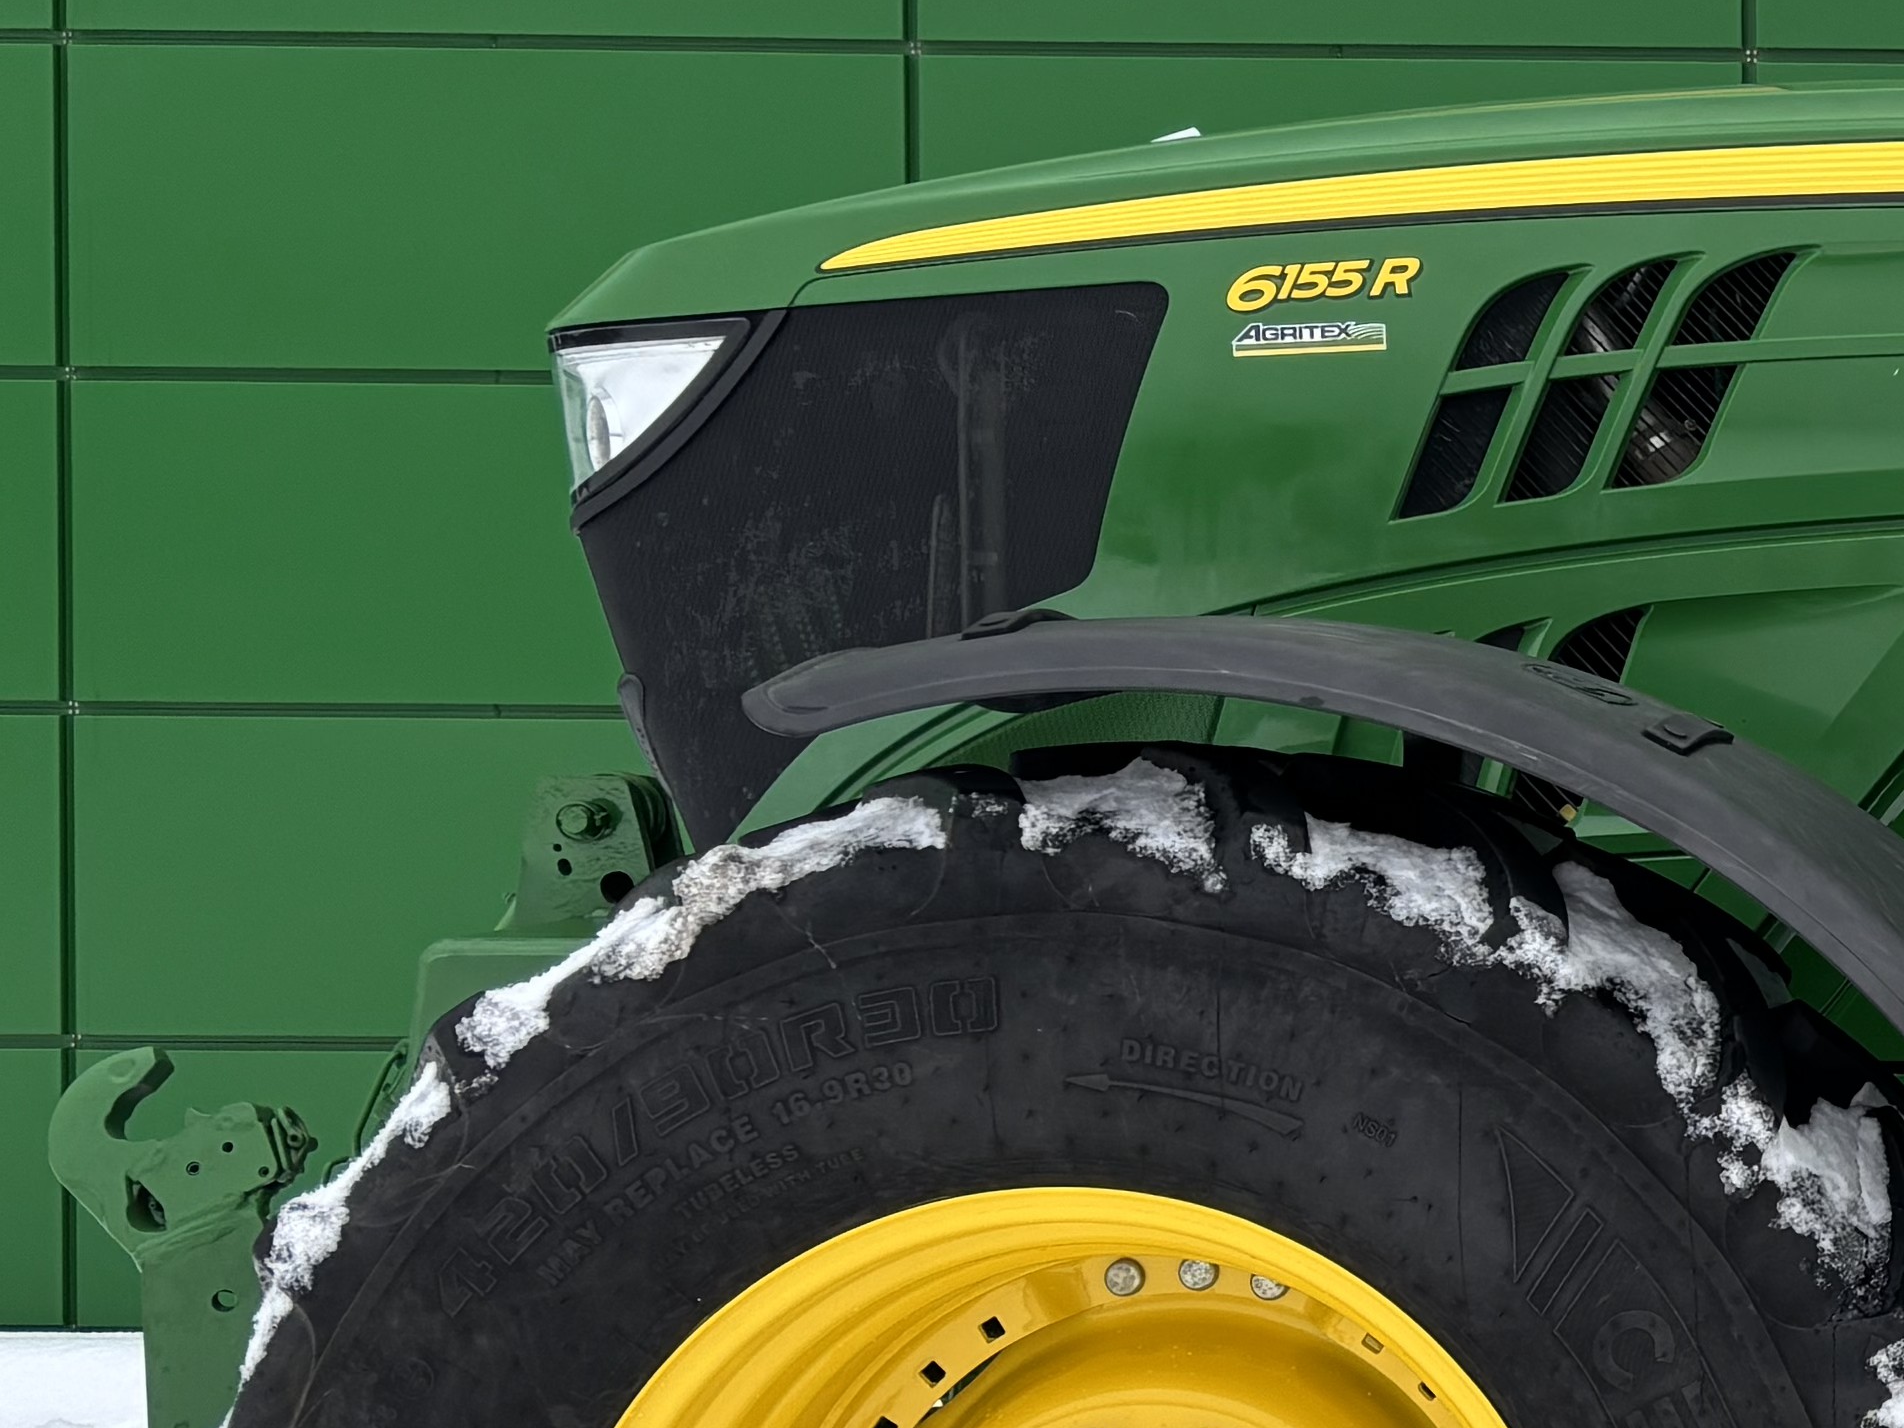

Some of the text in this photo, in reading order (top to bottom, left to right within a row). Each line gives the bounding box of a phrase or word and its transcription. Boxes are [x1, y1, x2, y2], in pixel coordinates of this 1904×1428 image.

[1226, 256, 1422, 313] 6155 R
[1236, 323, 1352, 343] AGRITEX
[1120, 1038, 1304, 1102] DIRECTION
[535, 1061, 914, 1288] MAY REPLACE 16.9R30
[672, 1143, 800, 1221] TUBELESS
